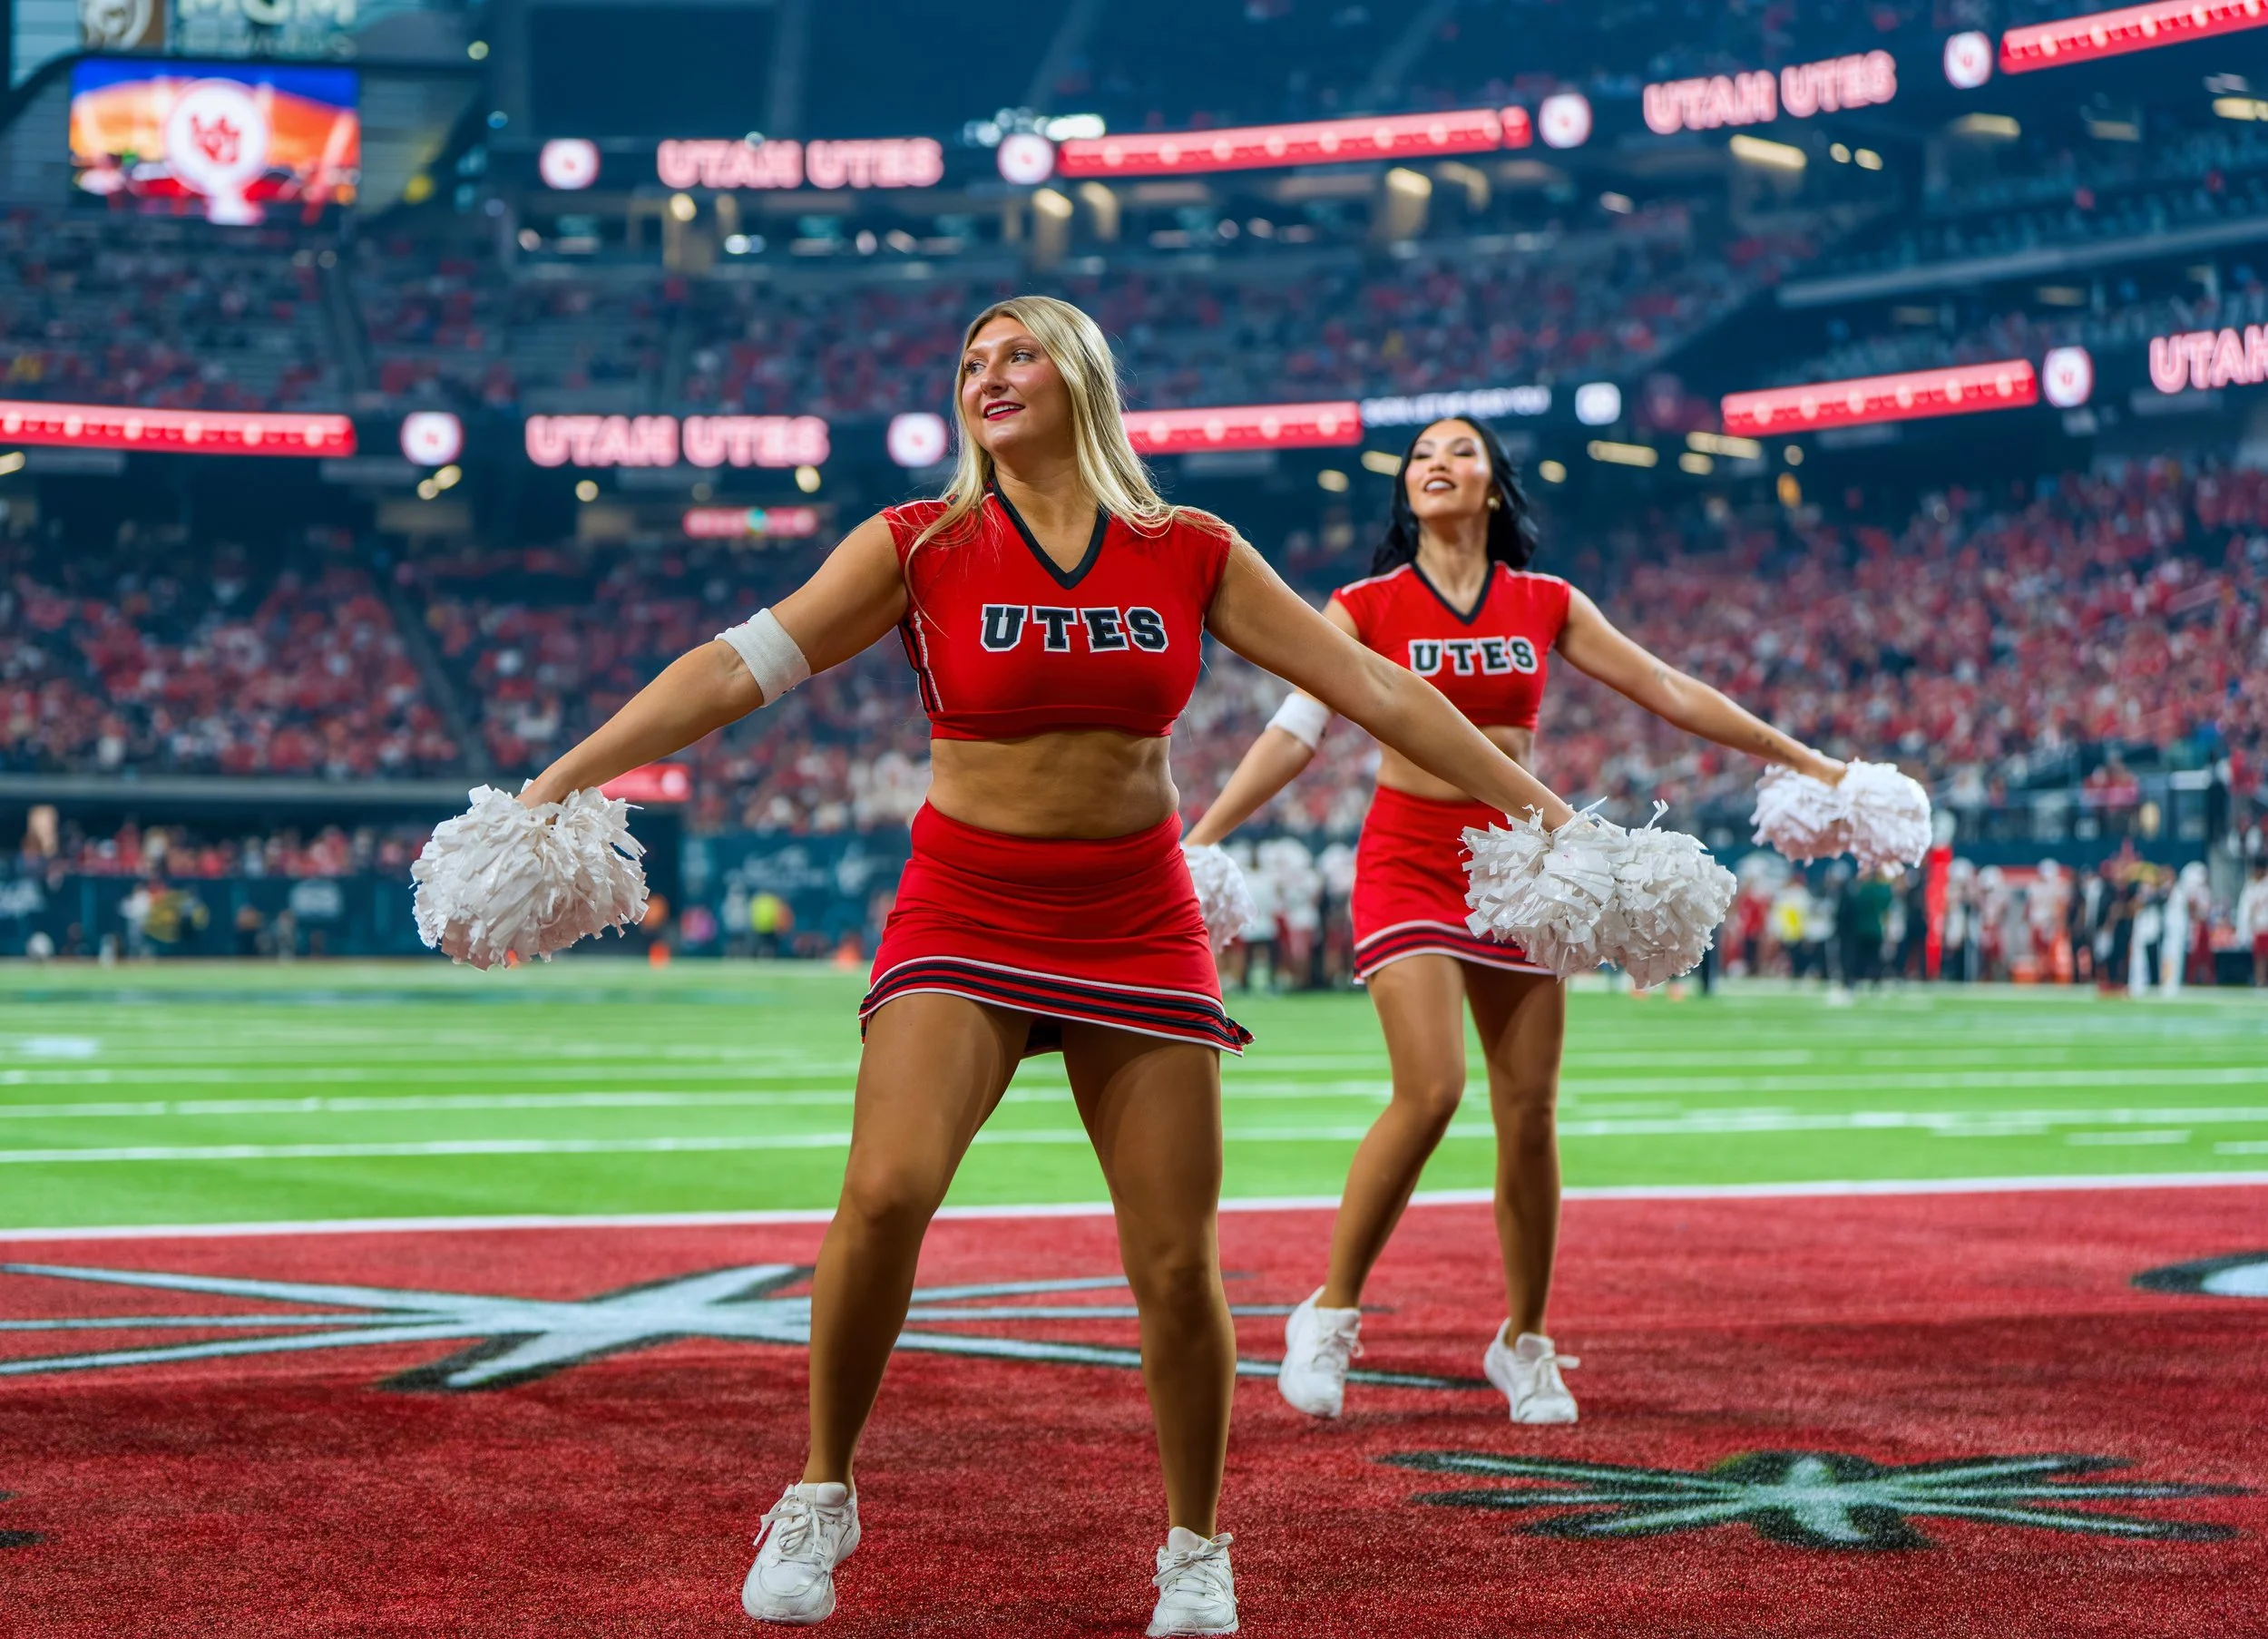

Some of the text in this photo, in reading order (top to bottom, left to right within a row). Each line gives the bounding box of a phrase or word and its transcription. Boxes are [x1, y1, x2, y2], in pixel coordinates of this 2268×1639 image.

[1643, 50, 1897, 134] UTAH UTES
[657, 137, 943, 189] UTAH UTES
[525, 415, 830, 467] UTAH UTES
[980, 603, 1169, 653] UTES
[1408, 635, 1540, 677] UTES
